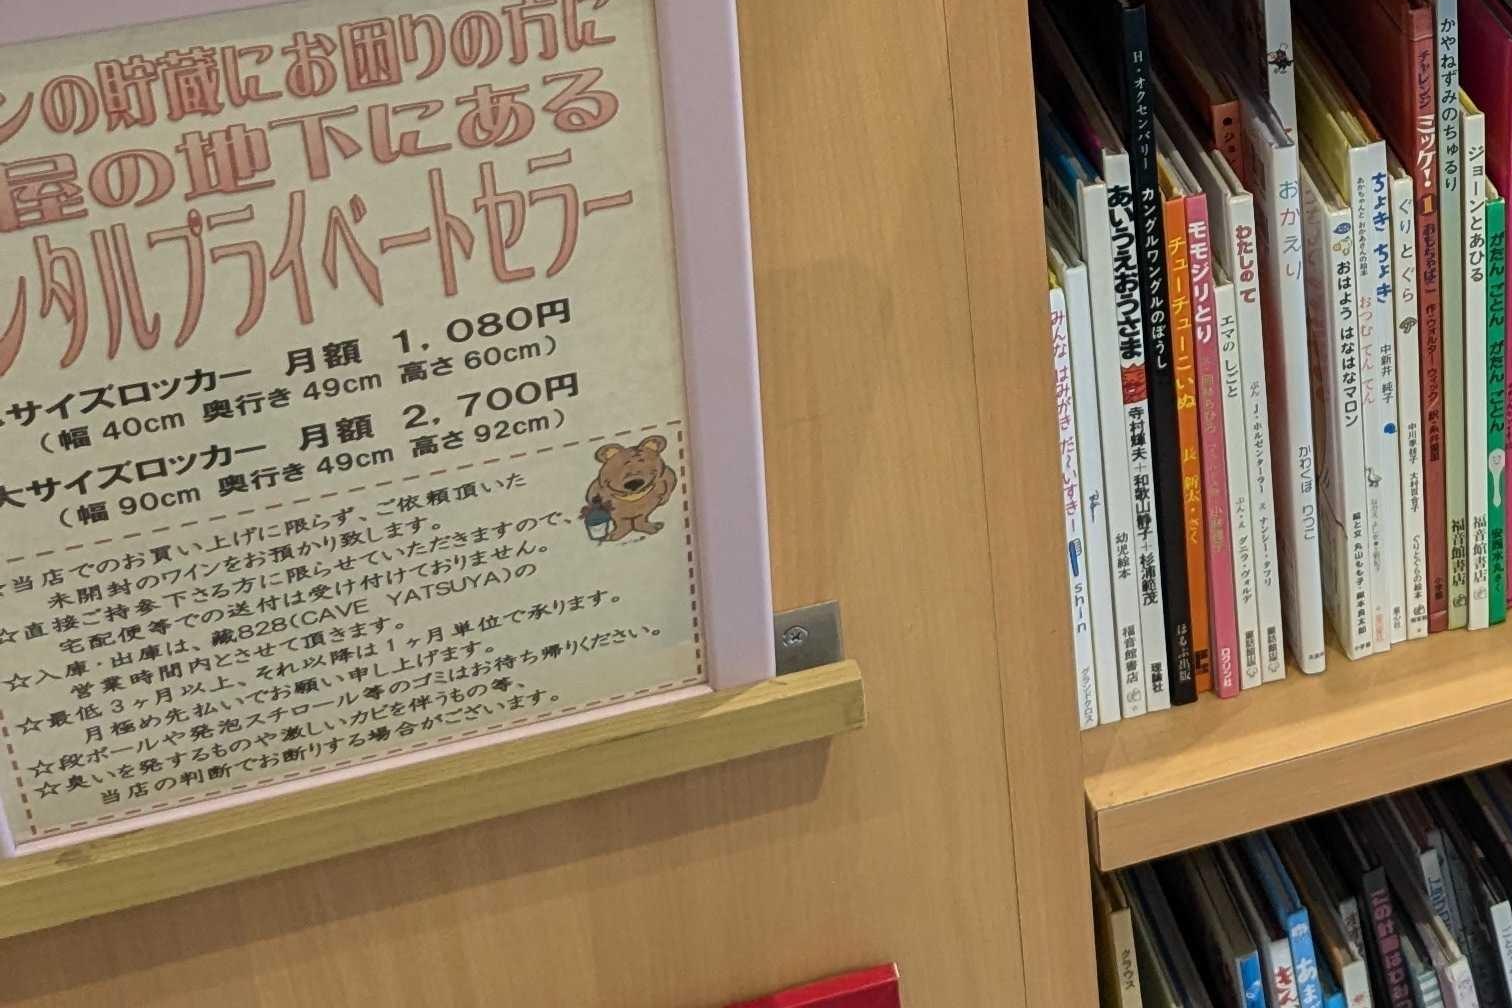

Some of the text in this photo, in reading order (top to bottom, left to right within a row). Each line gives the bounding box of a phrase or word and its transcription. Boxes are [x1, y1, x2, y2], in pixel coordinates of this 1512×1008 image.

[0, 68, 619, 233] 屋の地下にある
[1417, 116, 1435, 189] ミッケ!
[1440, 18, 1459, 192] かやねずみのちゅるり
[1108, 184, 1143, 360] あいうえおうさま
[1141, 187, 1167, 370] カングルワングルのぼうし
[1236, 224, 1254, 283] わたしの
[1279, 180, 1302, 281] おかえり
[1372, 172, 1392, 304] ちょき ちょき
[1400, 197, 1416, 302] ぐりとぐら
[1489, 231, 1505, 277] がたん
[1337, 260, 1352, 321] おはよう
[0, 369, 251, 427] サイズロッカー
[286, 339, 362, 376] 月額
[102, 411, 185, 440] 40cm
[202, 387, 291, 422] 奥行き
[303, 373, 382, 401] 49cm
[398, 357, 453, 384] 高さ
[464, 334, 556, 370] 60cm)
[0, 444, 266, 508] 大サイズロッカー
[300, 414, 374, 451] 月額
[119, 486, 200, 515] 90cm
[218, 463, 304, 496] 奥行き
[317, 448, 394, 474] 49cm
[410, 430, 464, 458] 高さ
[474, 409, 565, 442] 92cm)
